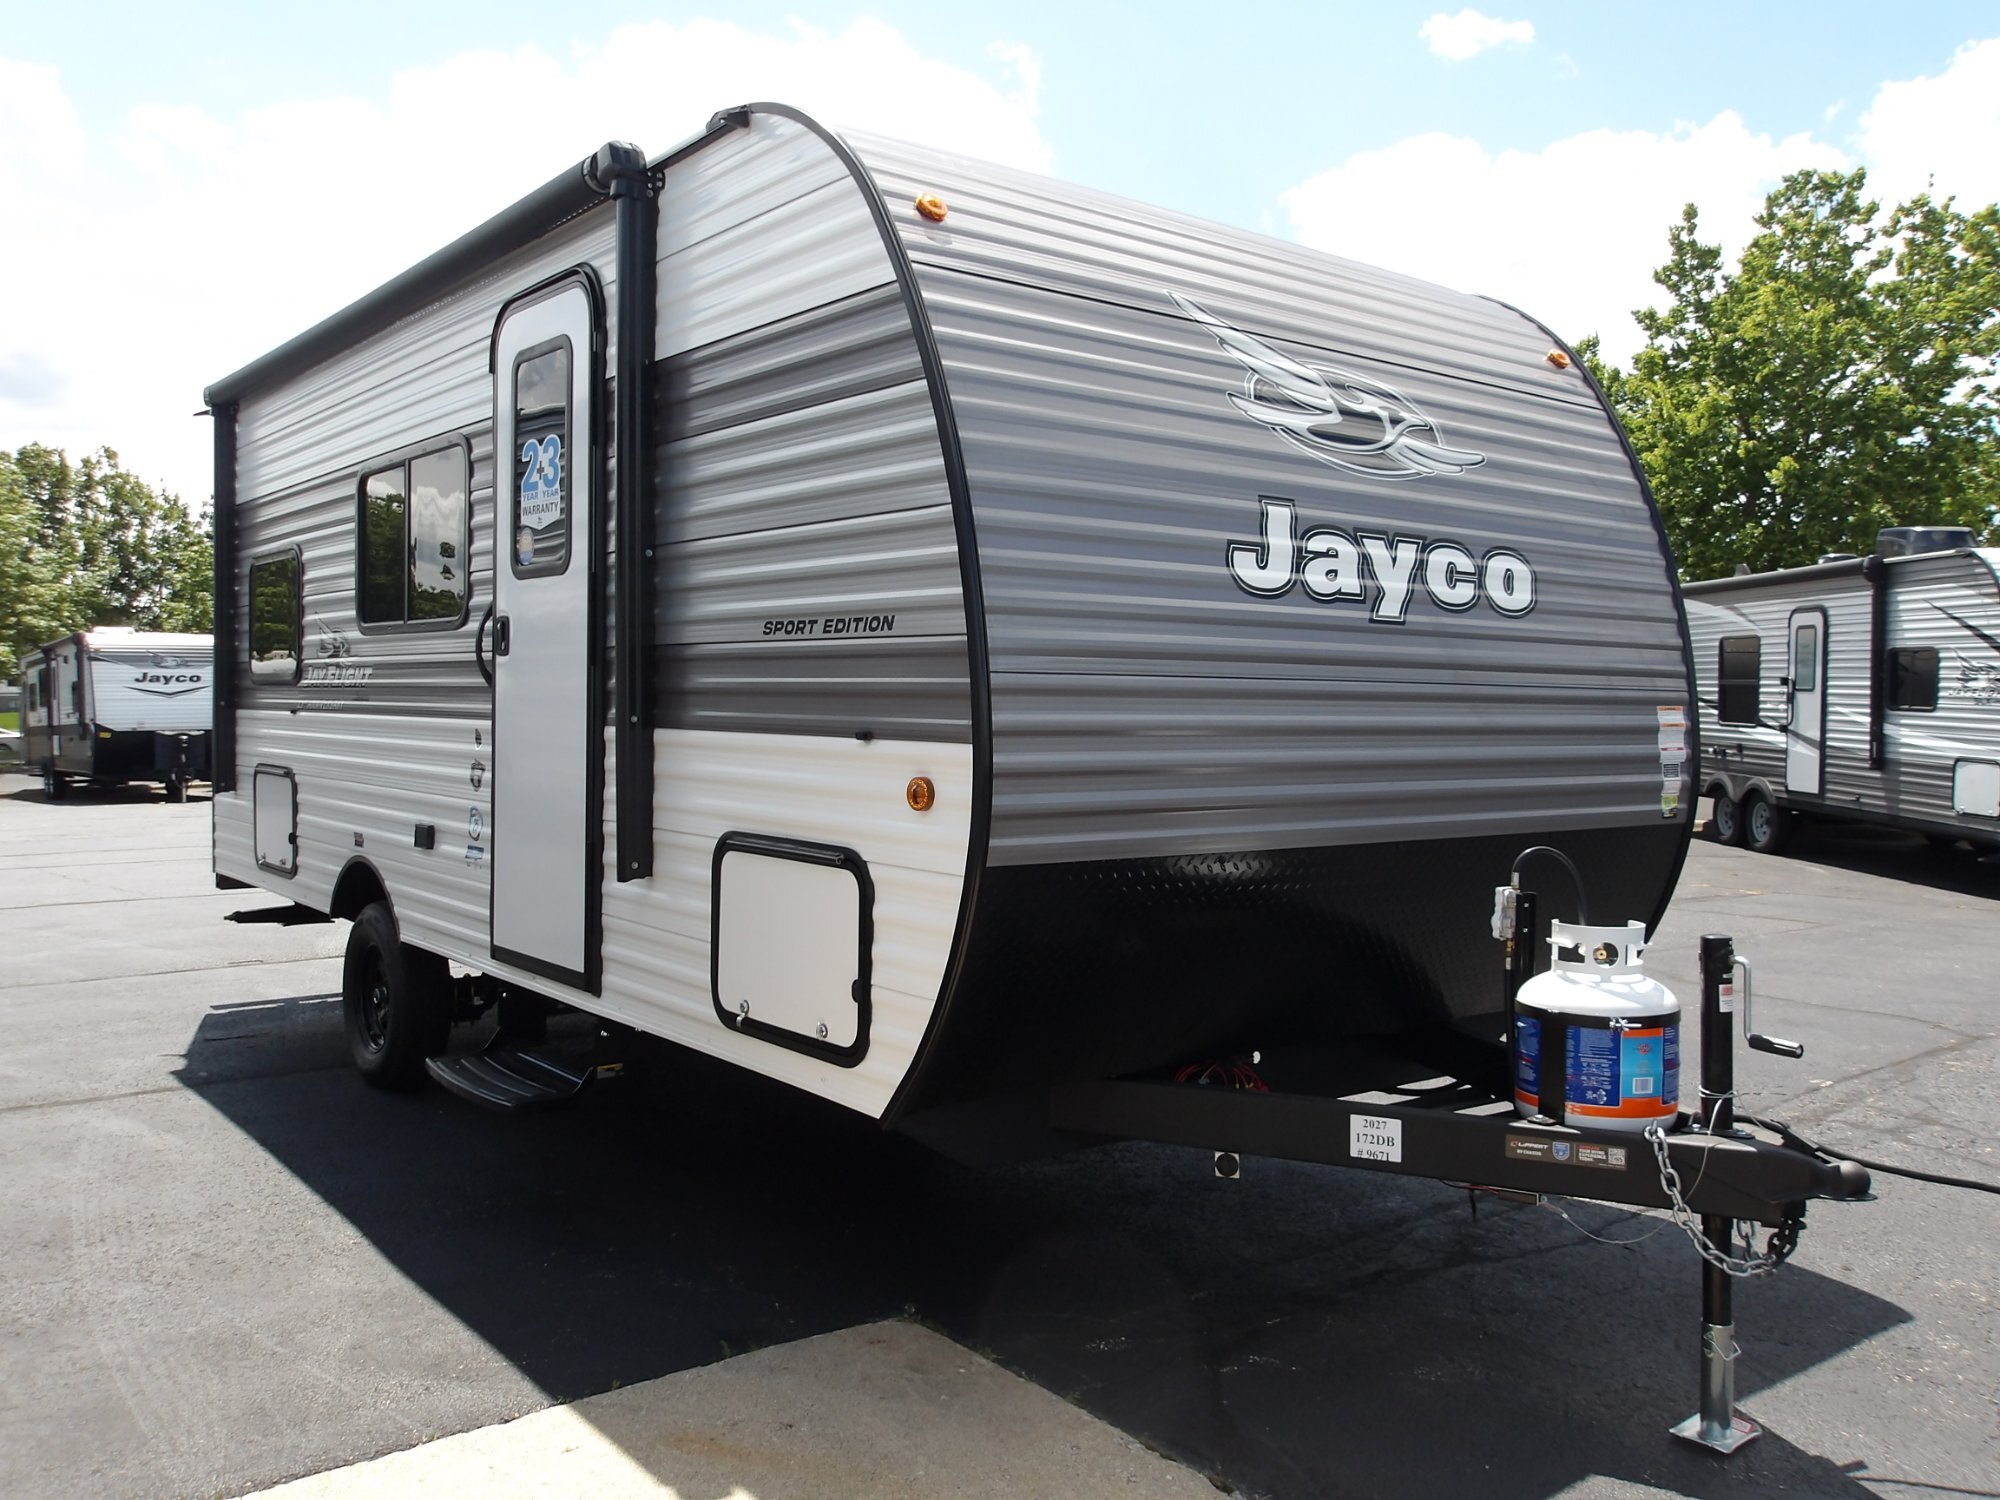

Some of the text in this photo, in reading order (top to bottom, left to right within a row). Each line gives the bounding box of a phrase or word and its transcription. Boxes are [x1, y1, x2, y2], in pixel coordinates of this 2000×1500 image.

[523, 487, 559, 502] YEAR YEAR
[522, 501, 559, 517] WARRANTY
[1226, 494, 1536, 625] Jayco
[763, 615, 896, 635] SPORT EDITION
[134, 672, 202, 685] Jayco
[327, 665, 373, 688] FLIGHT
[1363, 1119, 1387, 1130] 2027
[1356, 1132, 1395, 1147] 172DB
[1366, 1149, 1389, 1161] 9671
